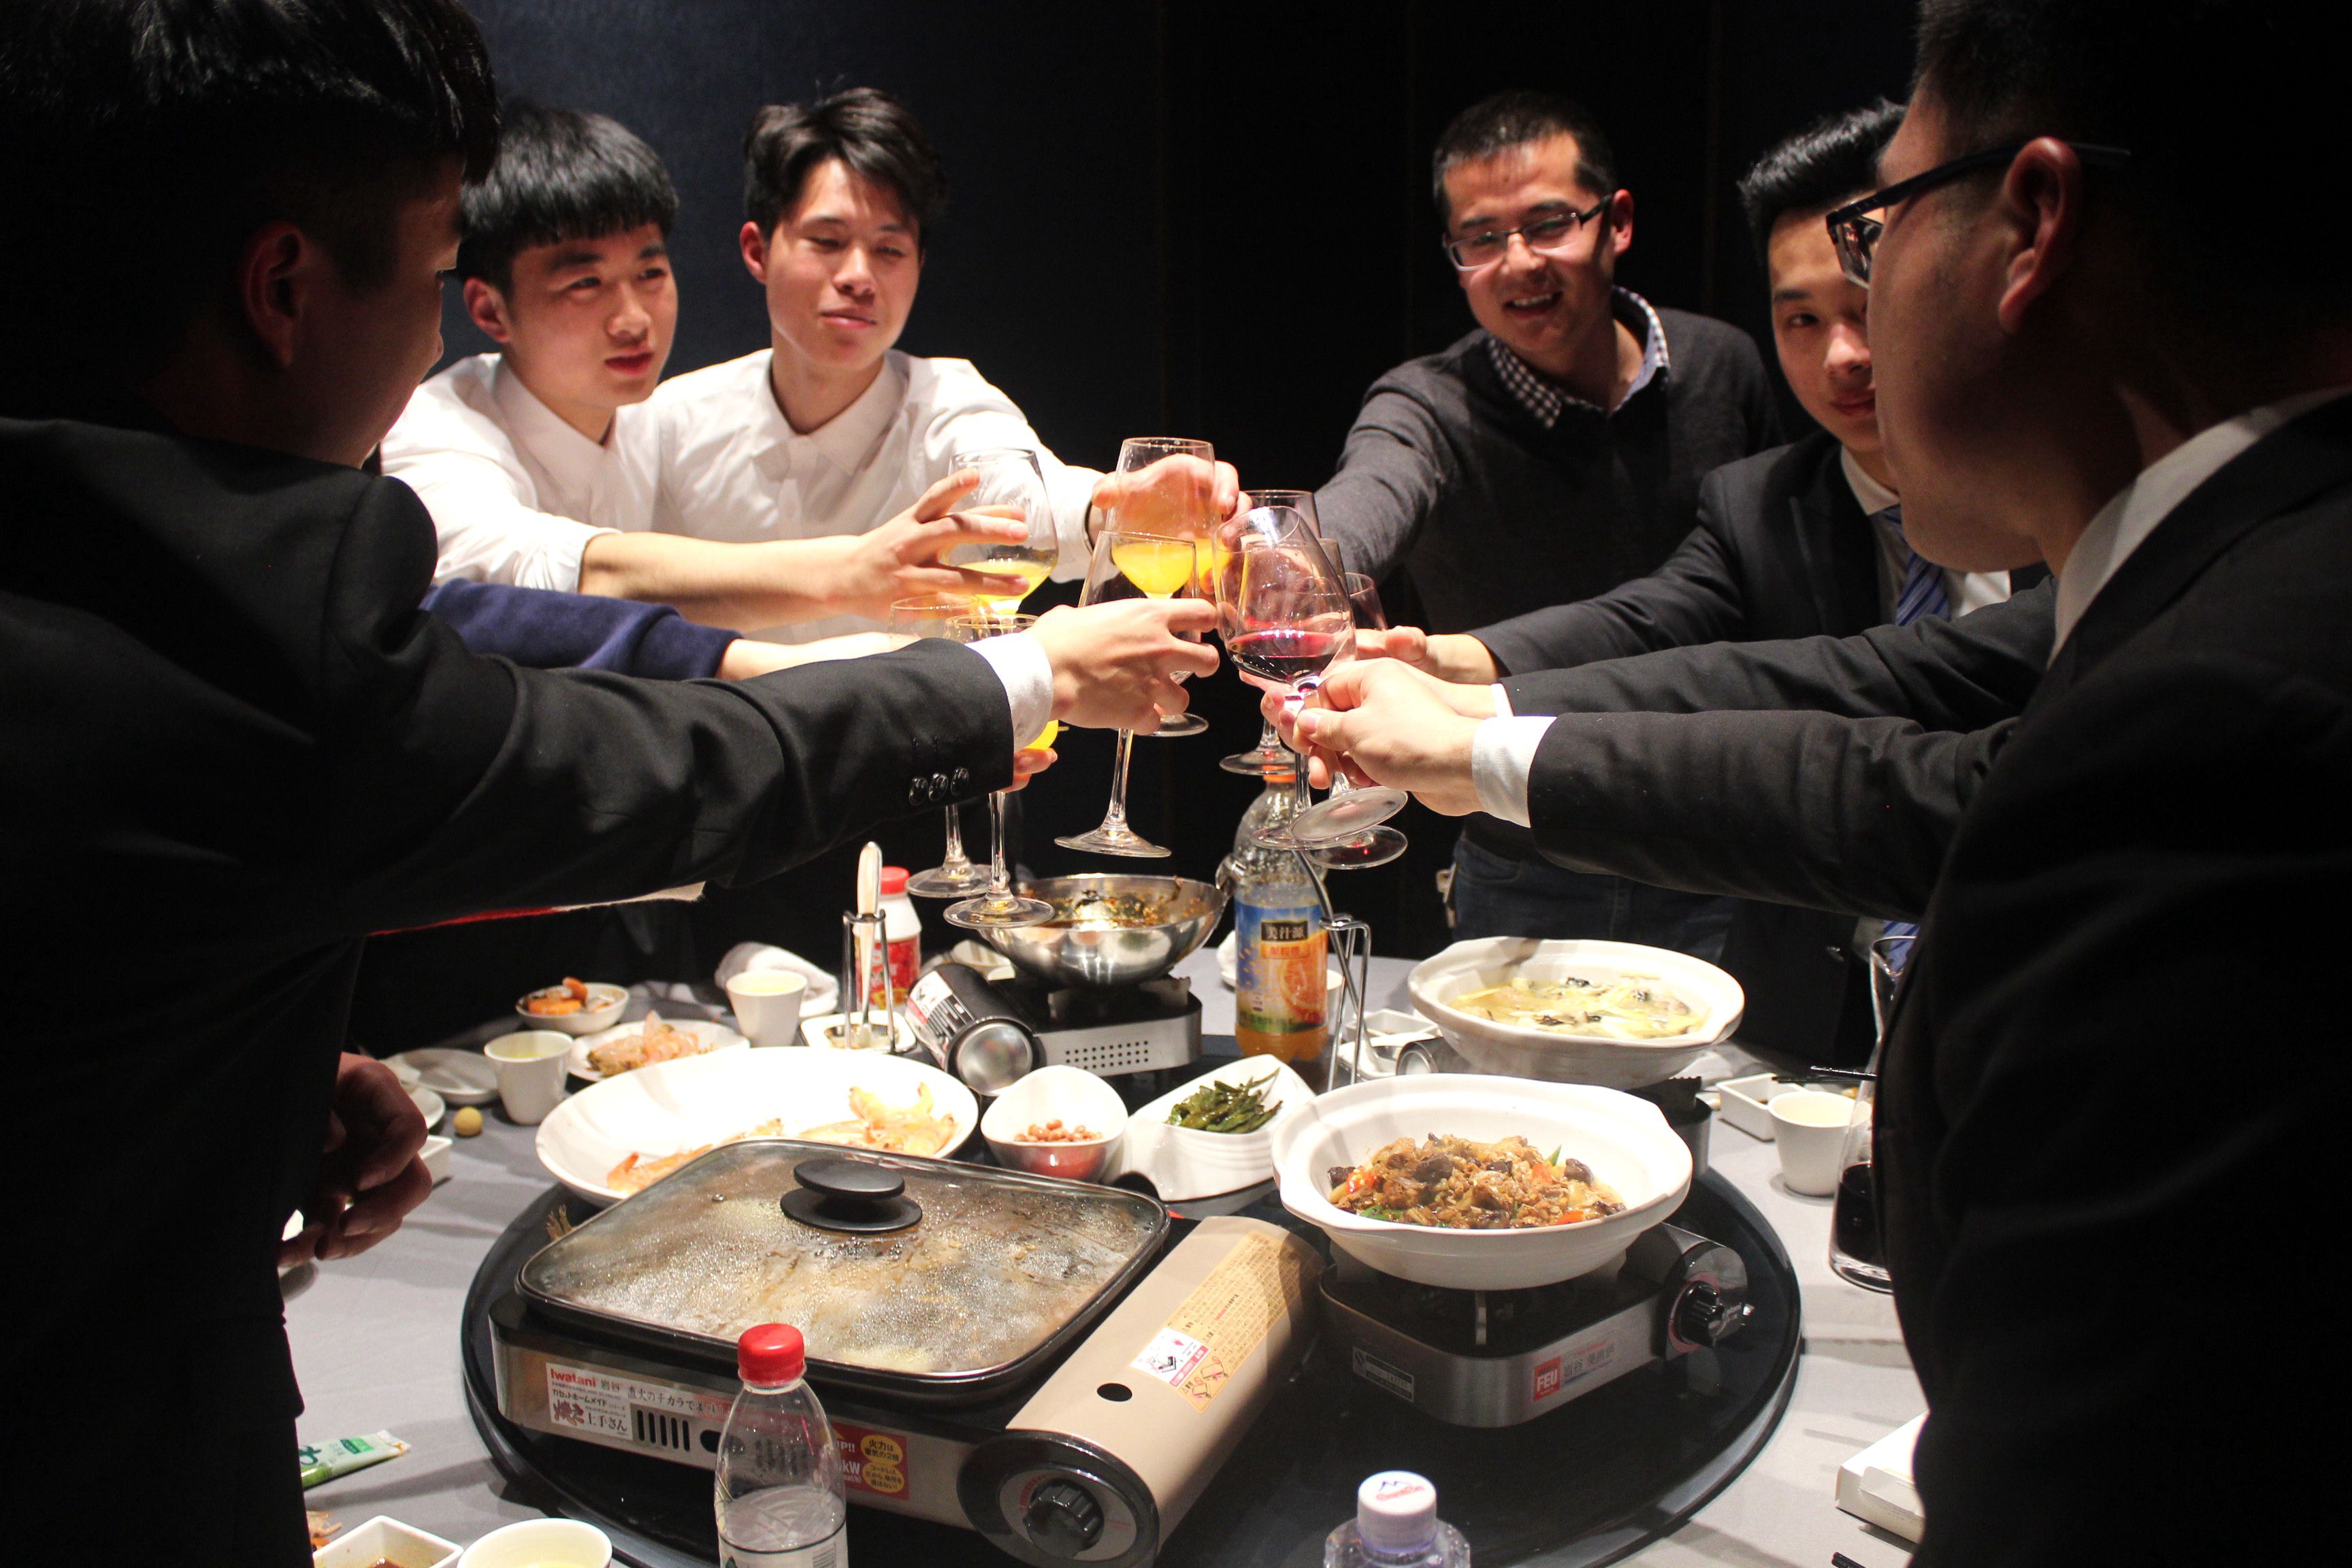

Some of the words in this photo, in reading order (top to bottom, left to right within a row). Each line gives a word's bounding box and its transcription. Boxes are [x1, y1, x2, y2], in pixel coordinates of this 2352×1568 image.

[550, 1368, 597, 1388] Iwatani
[1537, 1369, 1558, 1392] FEU
[869, 1439, 894, 1452] 火力は
